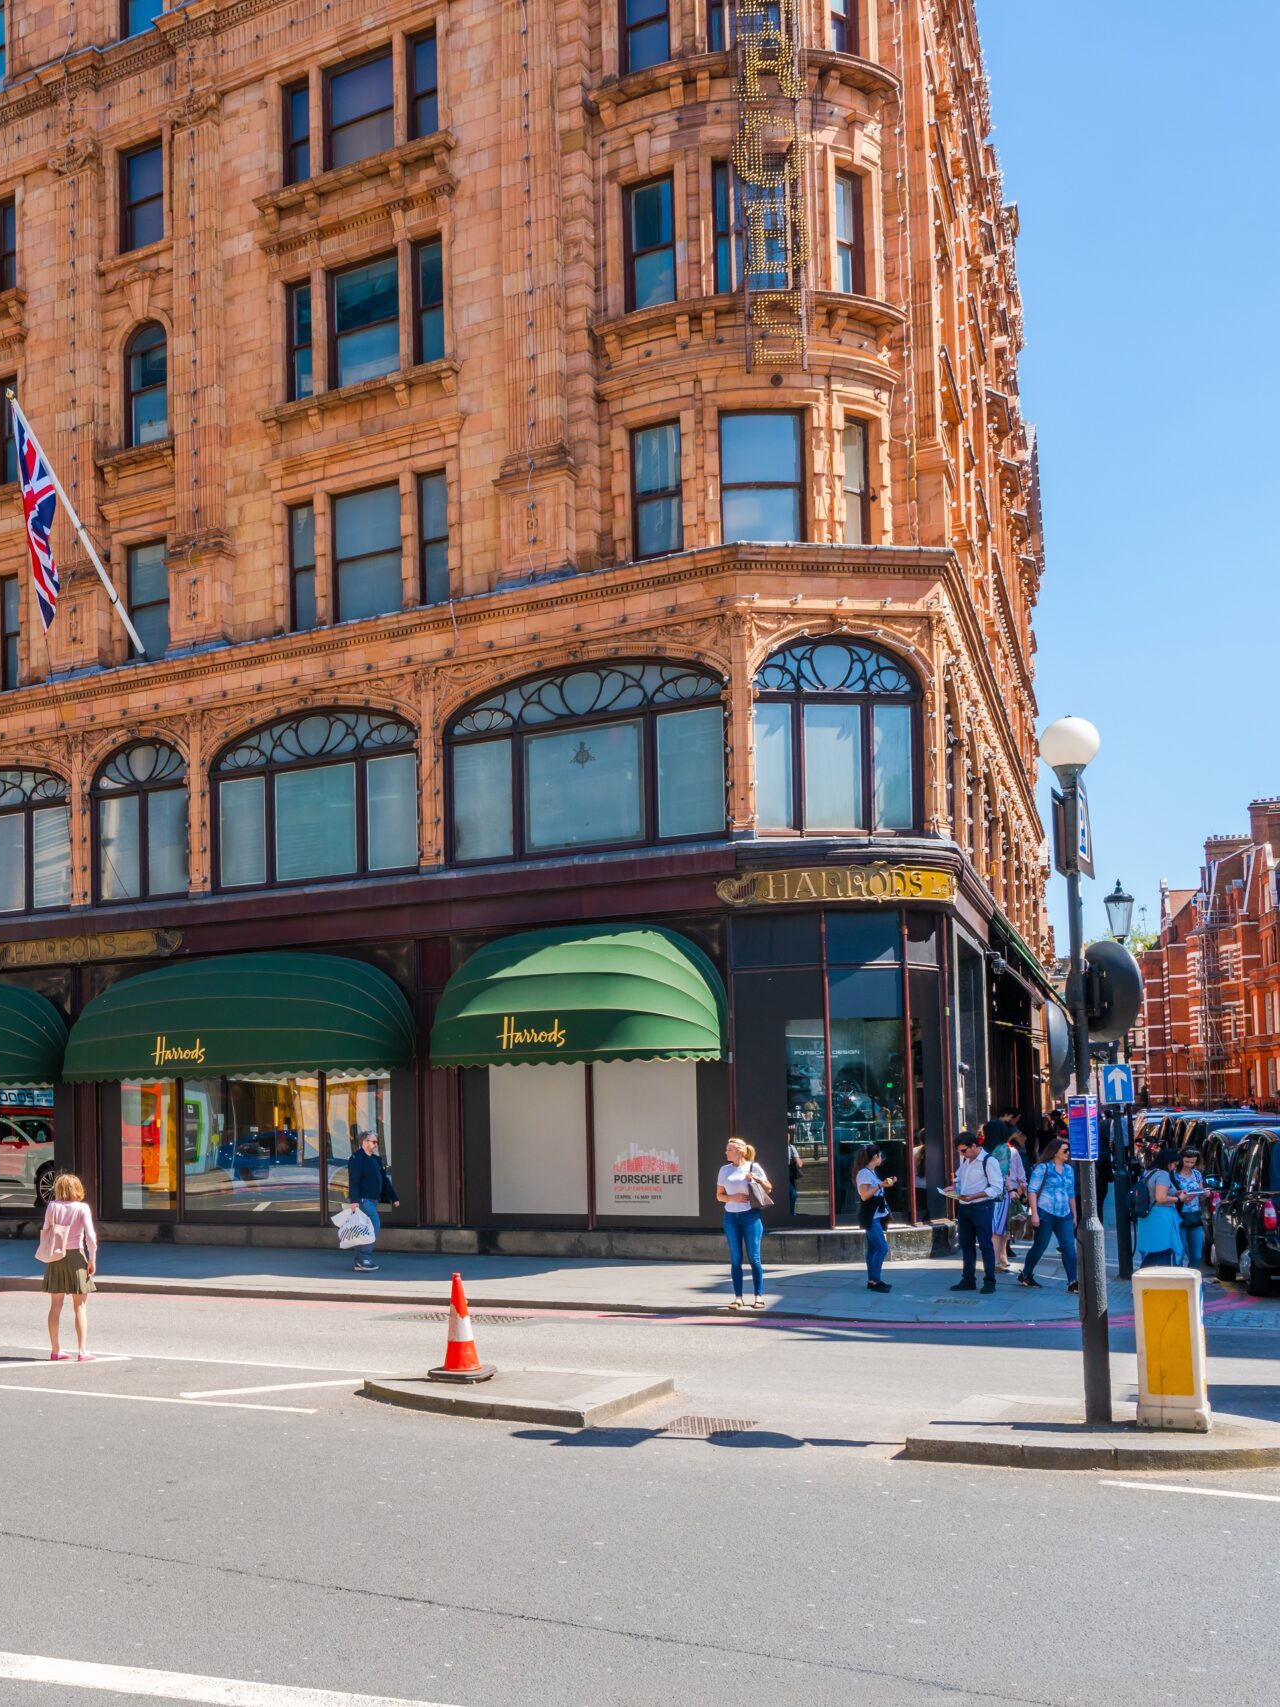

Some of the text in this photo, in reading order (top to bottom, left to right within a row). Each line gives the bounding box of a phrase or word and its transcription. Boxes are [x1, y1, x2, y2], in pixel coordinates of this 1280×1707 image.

[762, 870, 924, 900] HARRODS
[6, 934, 117, 965] HARRODS
[496, 1016, 566, 1050] Harrods
[150, 1036, 206, 1066] Harrods
[614, 1174, 684, 1184] PORSCHE LIFE
